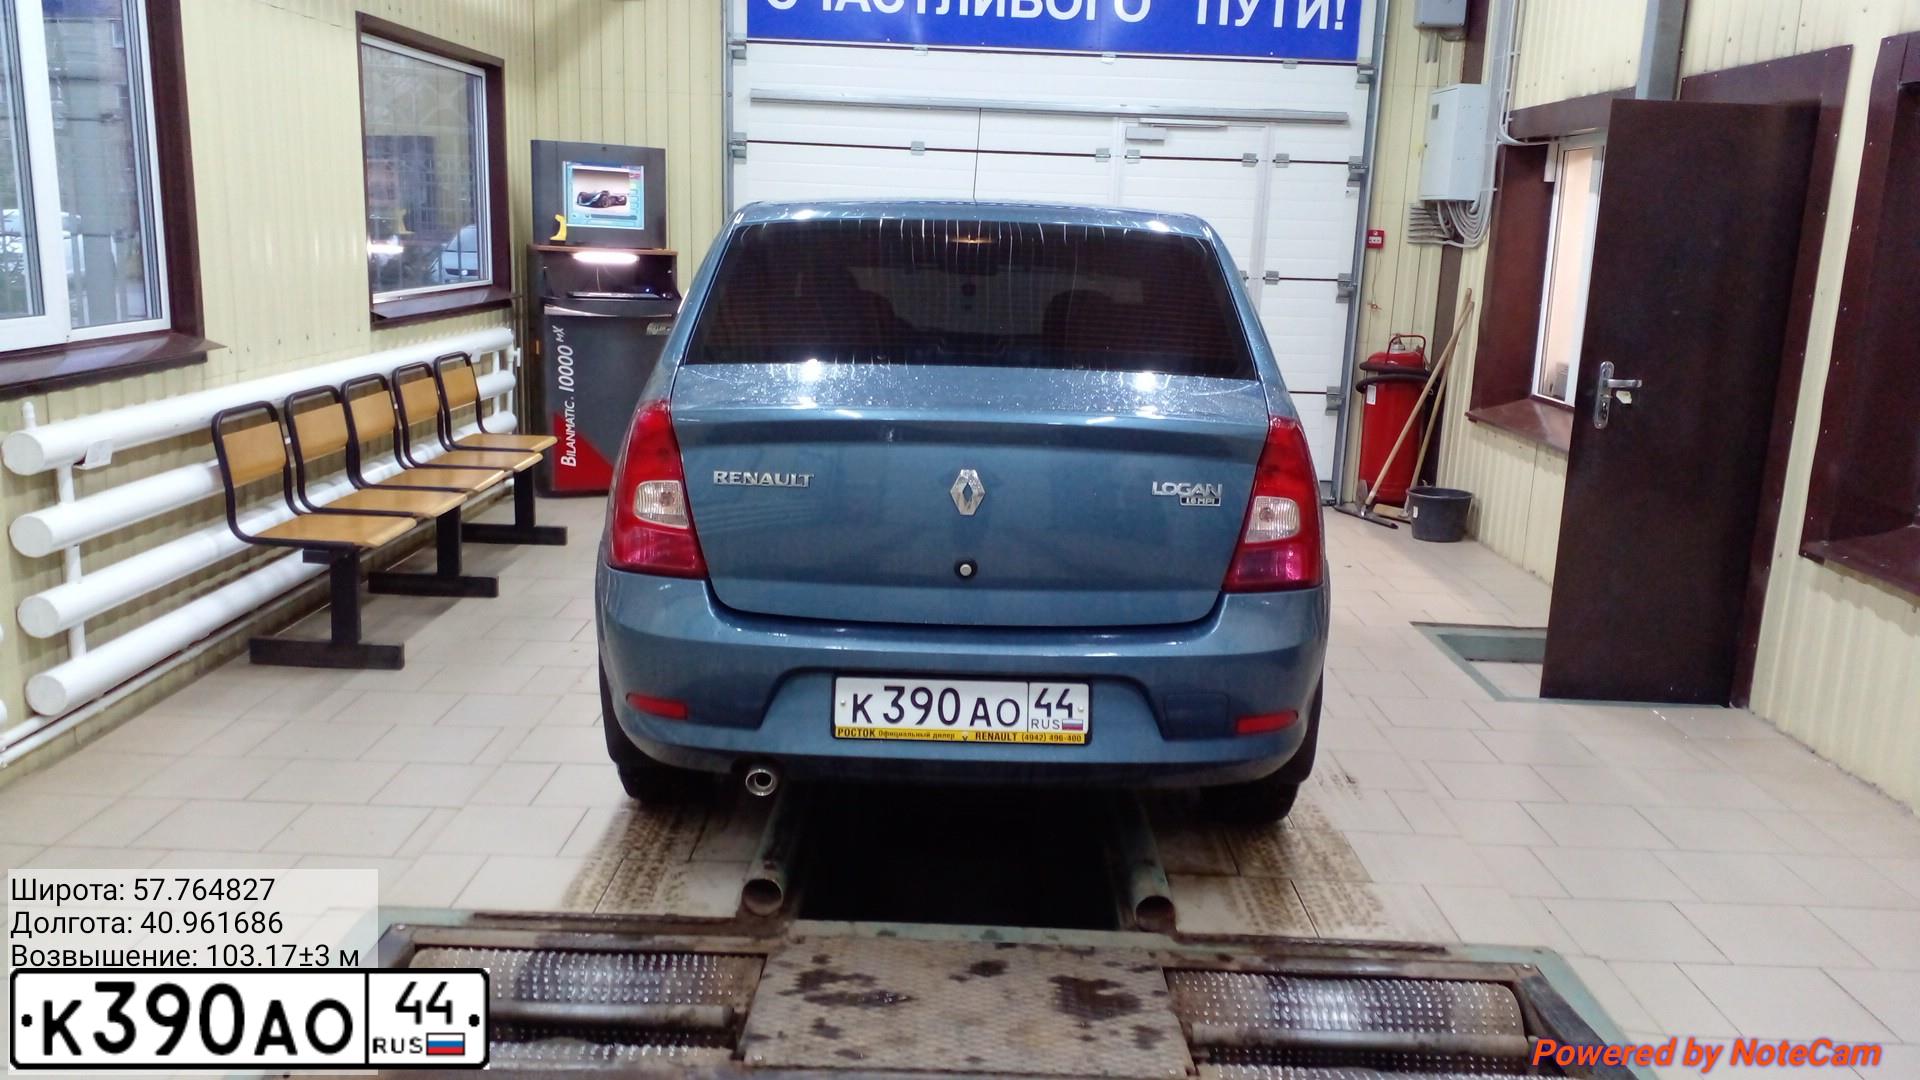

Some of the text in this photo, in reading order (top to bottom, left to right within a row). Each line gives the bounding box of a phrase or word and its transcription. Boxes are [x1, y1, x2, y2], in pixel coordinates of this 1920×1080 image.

[1196, 0, 1345, 31] ПУТИ!
[557, 345, 575, 392] 10000
[713, 470, 814, 488] RENAULT
[1151, 481, 1222, 497] LOGAN
[1033, 687, 1074, 718] 44
[1031, 718, 1061, 731] RUS
[837, 727, 956, 740] РОСТОК Официальный дилер
[975, 731, 1017, 742] RENAULT
